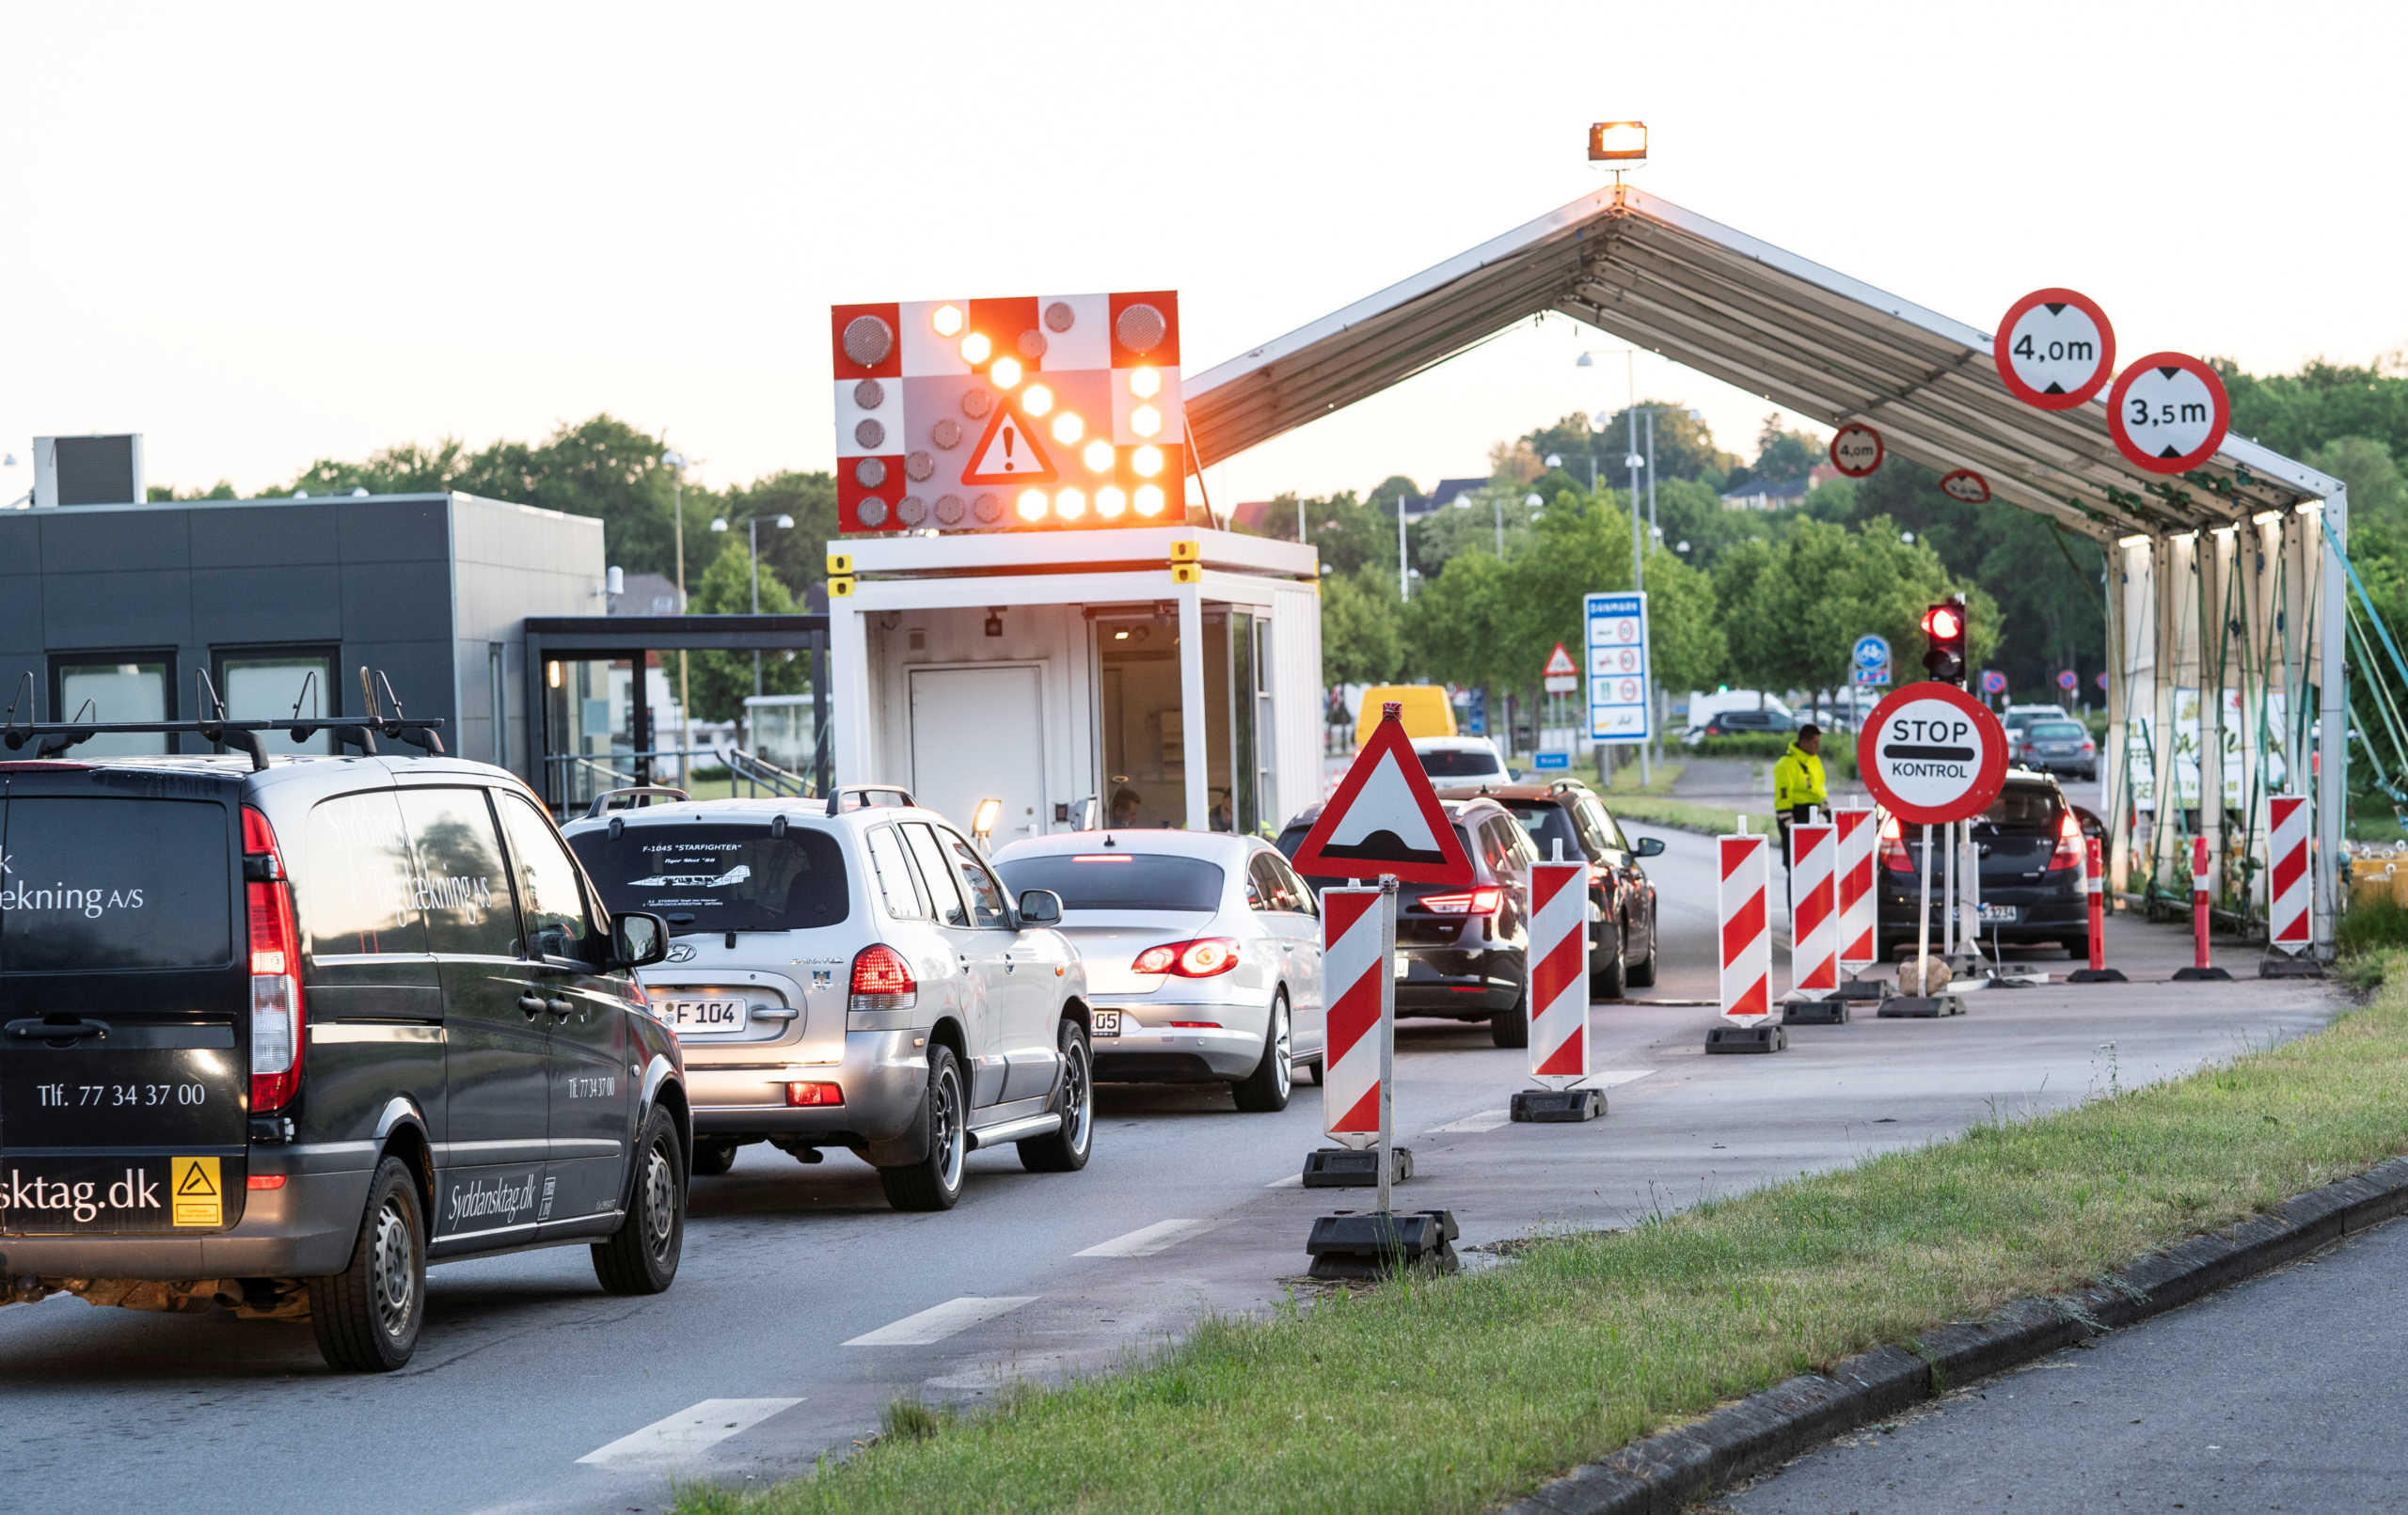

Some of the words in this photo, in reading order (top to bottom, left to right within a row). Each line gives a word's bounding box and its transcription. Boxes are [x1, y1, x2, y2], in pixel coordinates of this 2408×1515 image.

[1893, 718, 1969, 743] STOP
[1892, 762, 1968, 779] KONTROL
[107, 889, 144, 908] A/S
[676, 1003, 690, 1024] F
[694, 1002, 735, 1024] 104
[1091, 1013, 1117, 1029] 05
[37, 1083, 69, 1107] Tlf.
[79, 1085, 104, 1106] 77
[112, 1084, 138, 1106] 34
[145, 1084, 171, 1106] 37
[178, 1083, 206, 1105] 00
[579, 1079, 589, 1098] 77
[589, 1078, 597, 1098] 34
[597, 1077, 607, 1097] 37
[606, 1076, 615, 1097] 00
[449, 1174, 537, 1232] Syddansktag.dk
